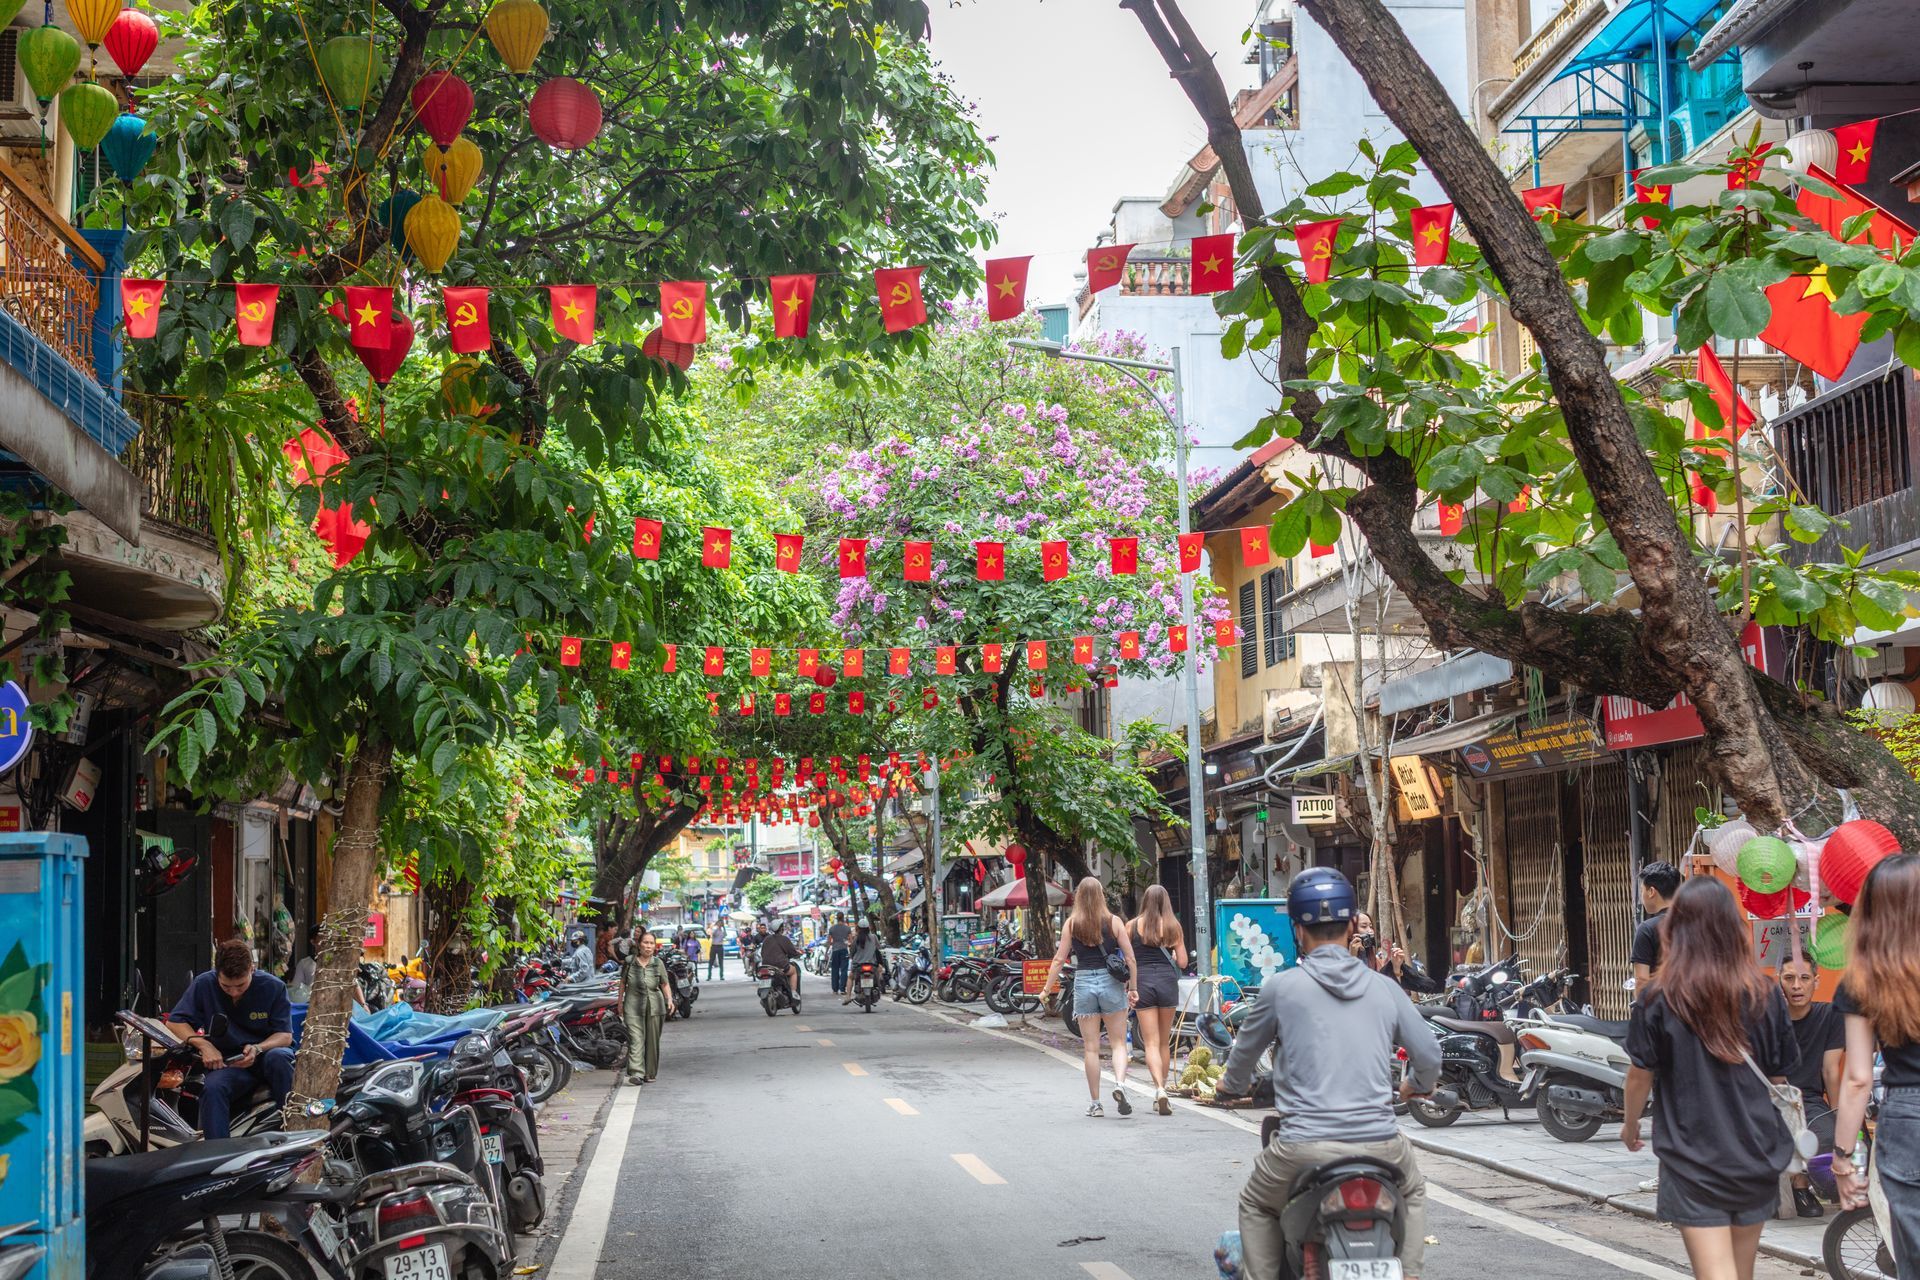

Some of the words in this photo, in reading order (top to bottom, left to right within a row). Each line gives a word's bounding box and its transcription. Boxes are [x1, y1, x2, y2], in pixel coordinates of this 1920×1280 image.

[1296, 799, 1334, 811] TATTOO
[181, 1178, 240, 1201] VISION
[394, 1248, 437, 1275] 29-Y3
